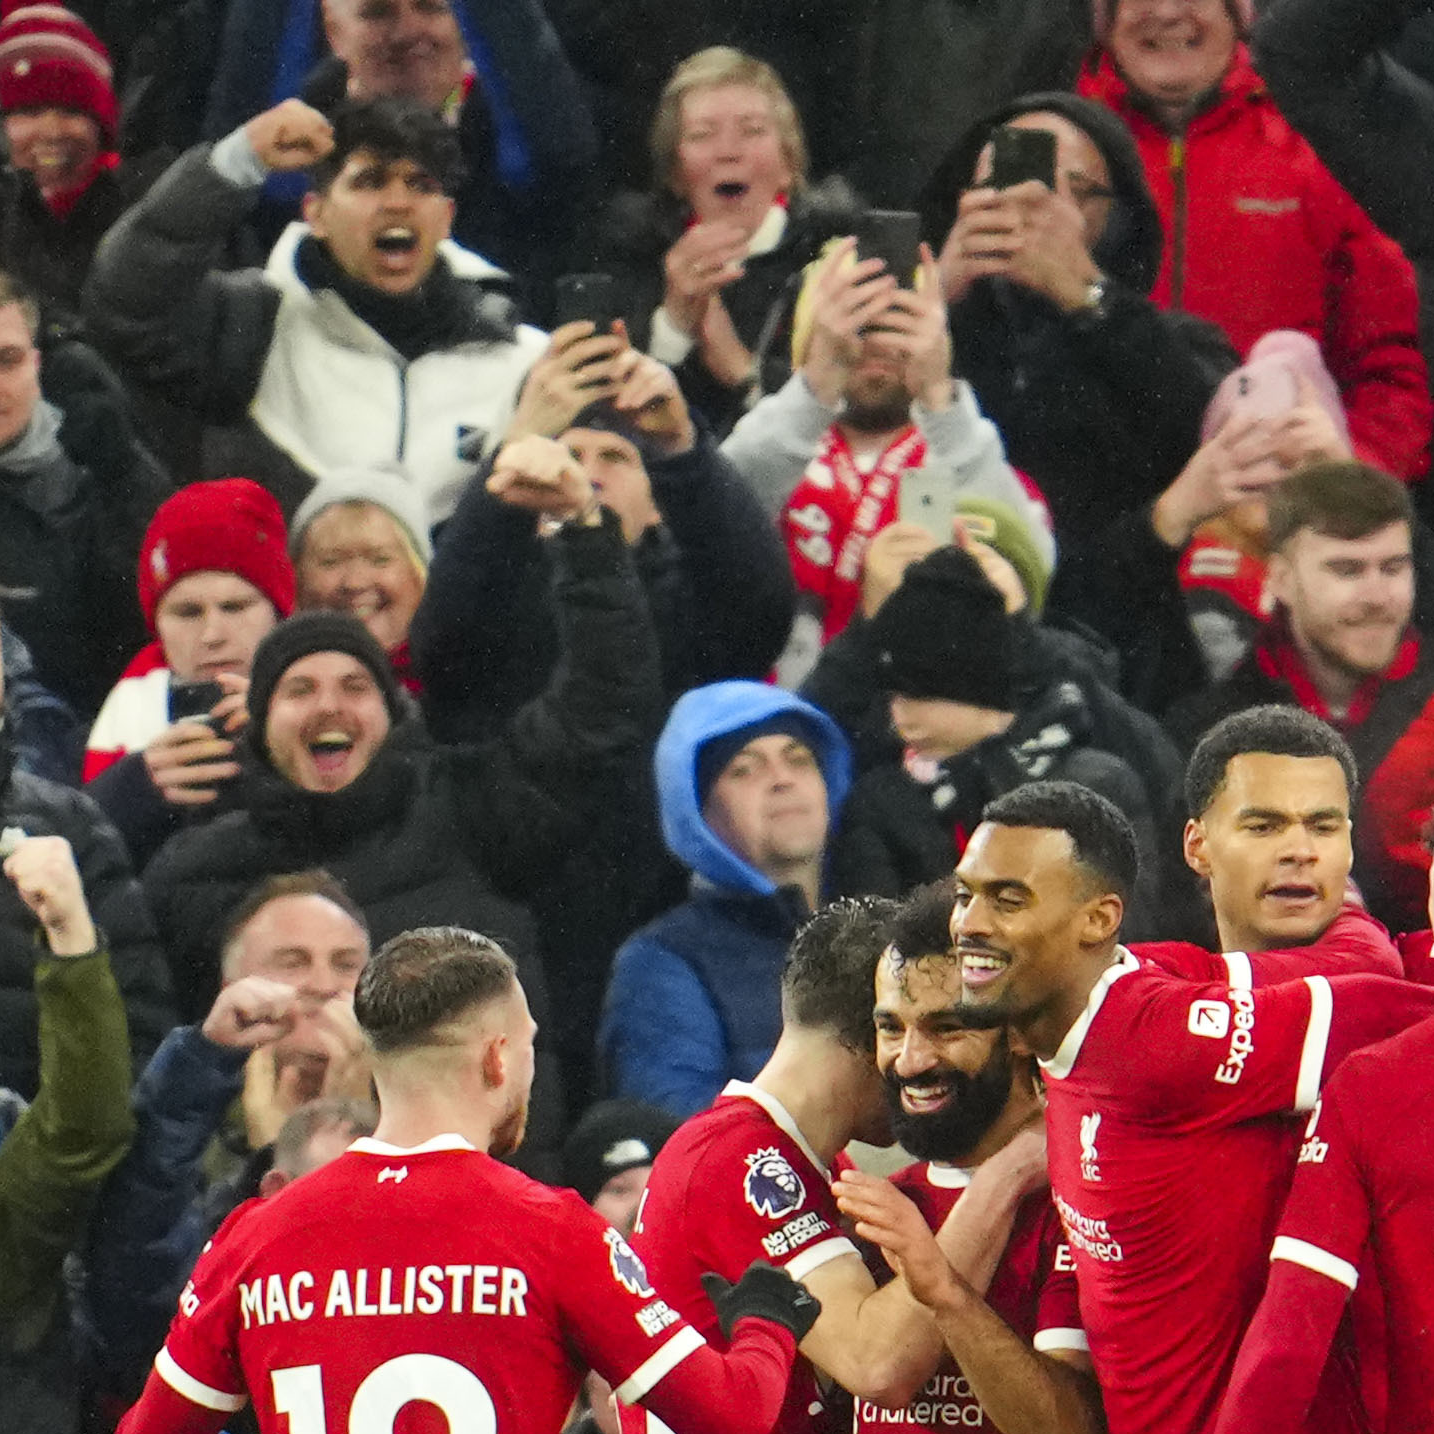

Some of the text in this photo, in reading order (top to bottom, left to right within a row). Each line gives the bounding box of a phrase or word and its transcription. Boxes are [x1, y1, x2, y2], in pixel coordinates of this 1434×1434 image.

[761, 1231, 786, 1249] No
[238, 1271, 315, 1330] MAC
[324, 1264, 529, 1318] ALLISTER
